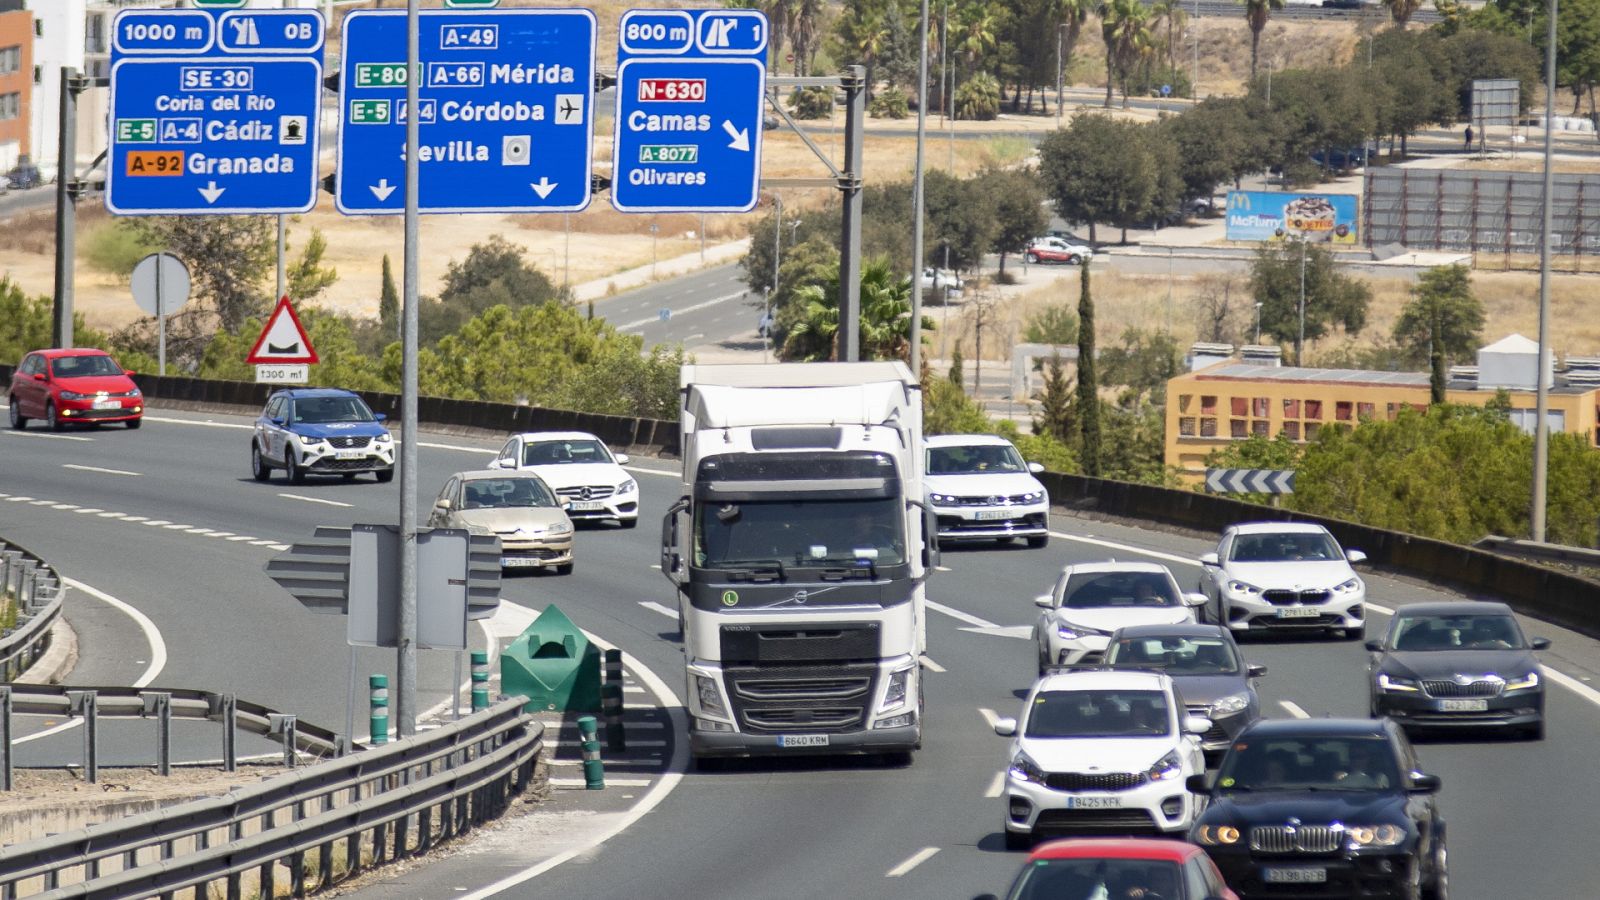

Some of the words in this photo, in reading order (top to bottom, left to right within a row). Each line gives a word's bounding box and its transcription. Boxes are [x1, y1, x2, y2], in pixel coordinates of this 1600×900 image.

[125, 24, 176, 40] 1000
[184, 27, 202, 40] m
[444, 28, 495, 46] A-49
[628, 24, 666, 40] 800
[670, 28, 686, 40] m
[752, 24, 760, 42] 1
[184, 70, 250, 87] SE-30
[359, 66, 420, 84] E-80
[434, 66, 481, 84] A-66
[490, 63, 574, 84] Mérida
[640, 81, 703, 99] N-630
[156, 95, 204, 111] Coria
[212, 94, 240, 110] del
[246, 94, 276, 110] Río
[353, 104, 388, 120] E-5
[442, 101, 544, 121] Córdoba
[119, 122, 154, 140] E-5
[164, 122, 199, 140] A-4
[205, 120, 272, 140] Cádiz
[628, 110, 711, 132] Camas
[131, 156, 181, 172] A-92
[188, 152, 294, 174] Granada
[642, 148, 696, 161] A-8077
[629, 168, 706, 186] Olivares
[785, 736, 808, 746] 6640
[810, 736, 827, 745] KRM
